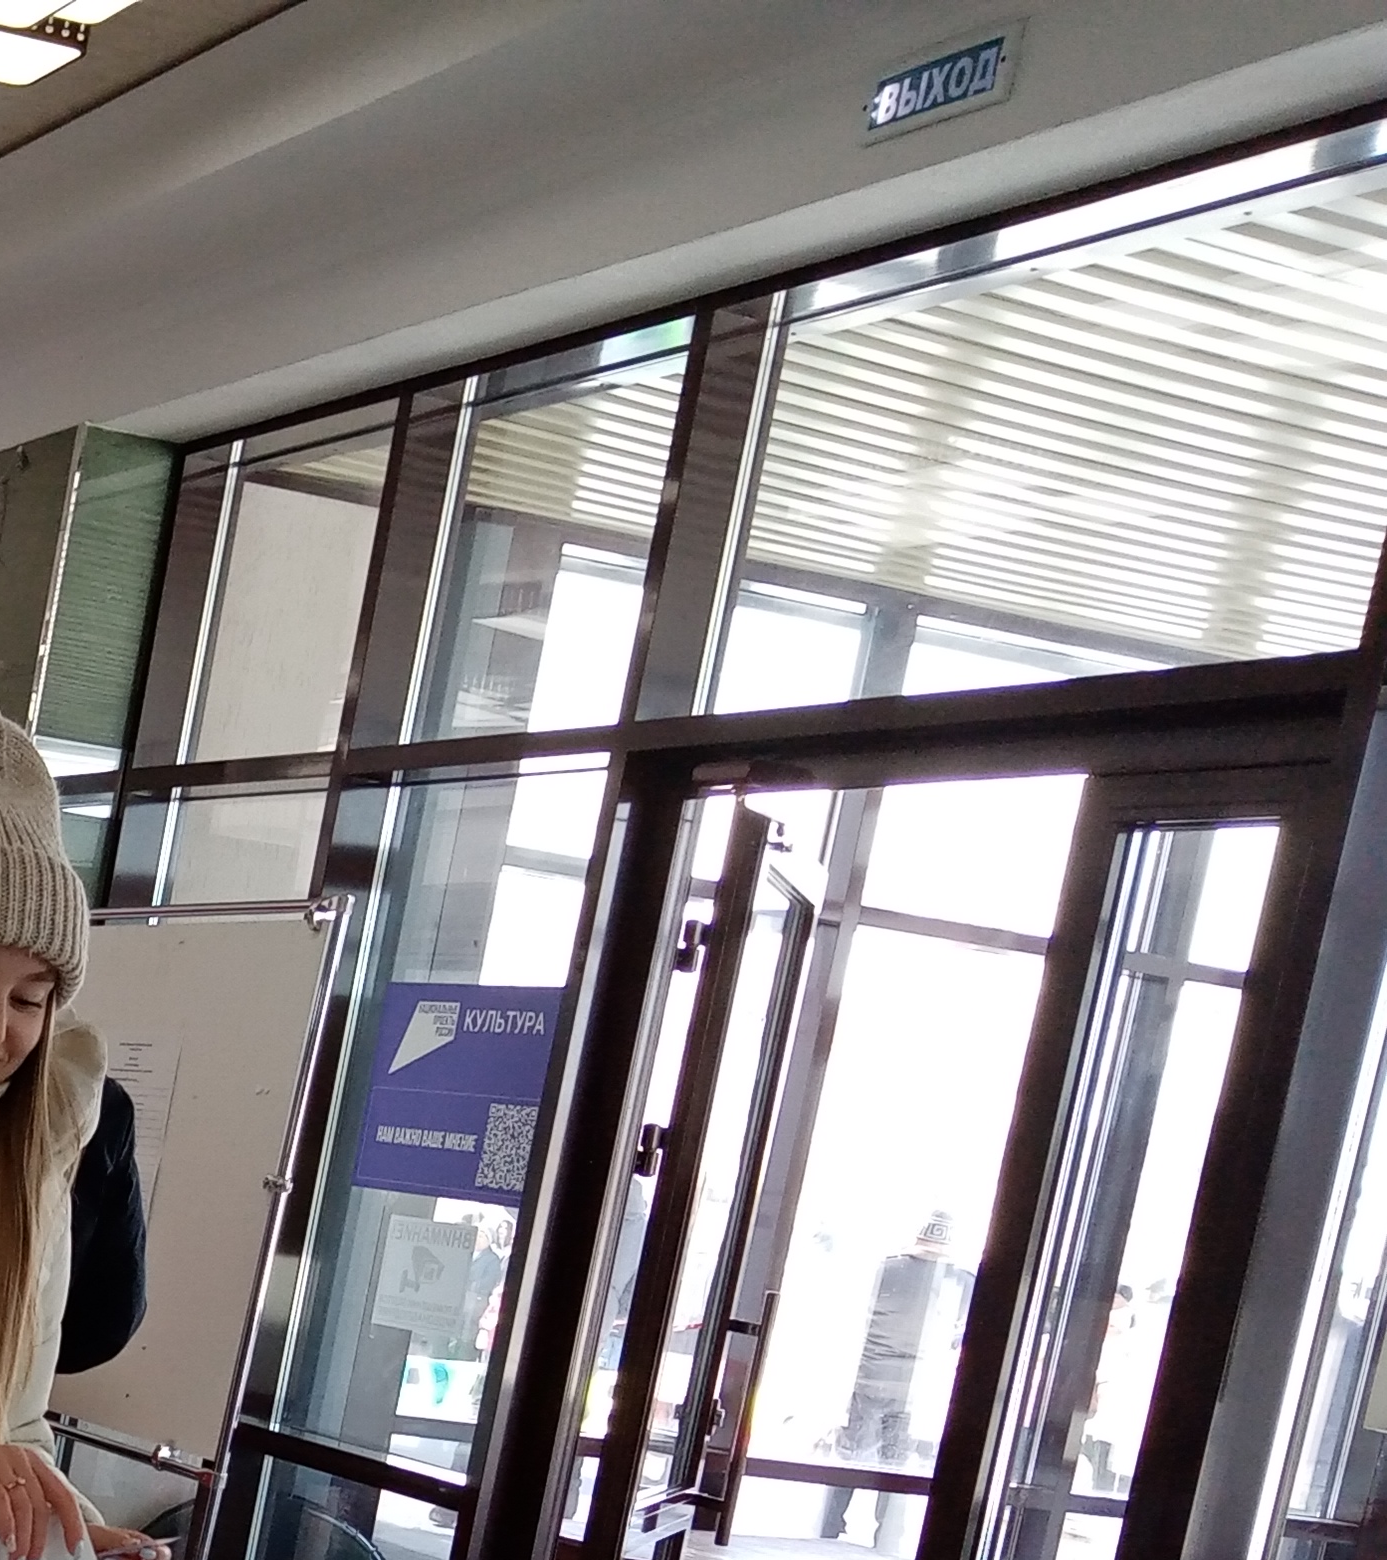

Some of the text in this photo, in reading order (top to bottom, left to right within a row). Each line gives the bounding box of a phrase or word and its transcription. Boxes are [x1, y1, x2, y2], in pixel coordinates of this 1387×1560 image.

[876, 47, 999, 125] ВЫХОД
[463, 1008, 545, 1036] КУЛЬТУРА
[375, 1125, 478, 1152] НАМ ВАЖНО ВАШЕ МНЕНИЕ
